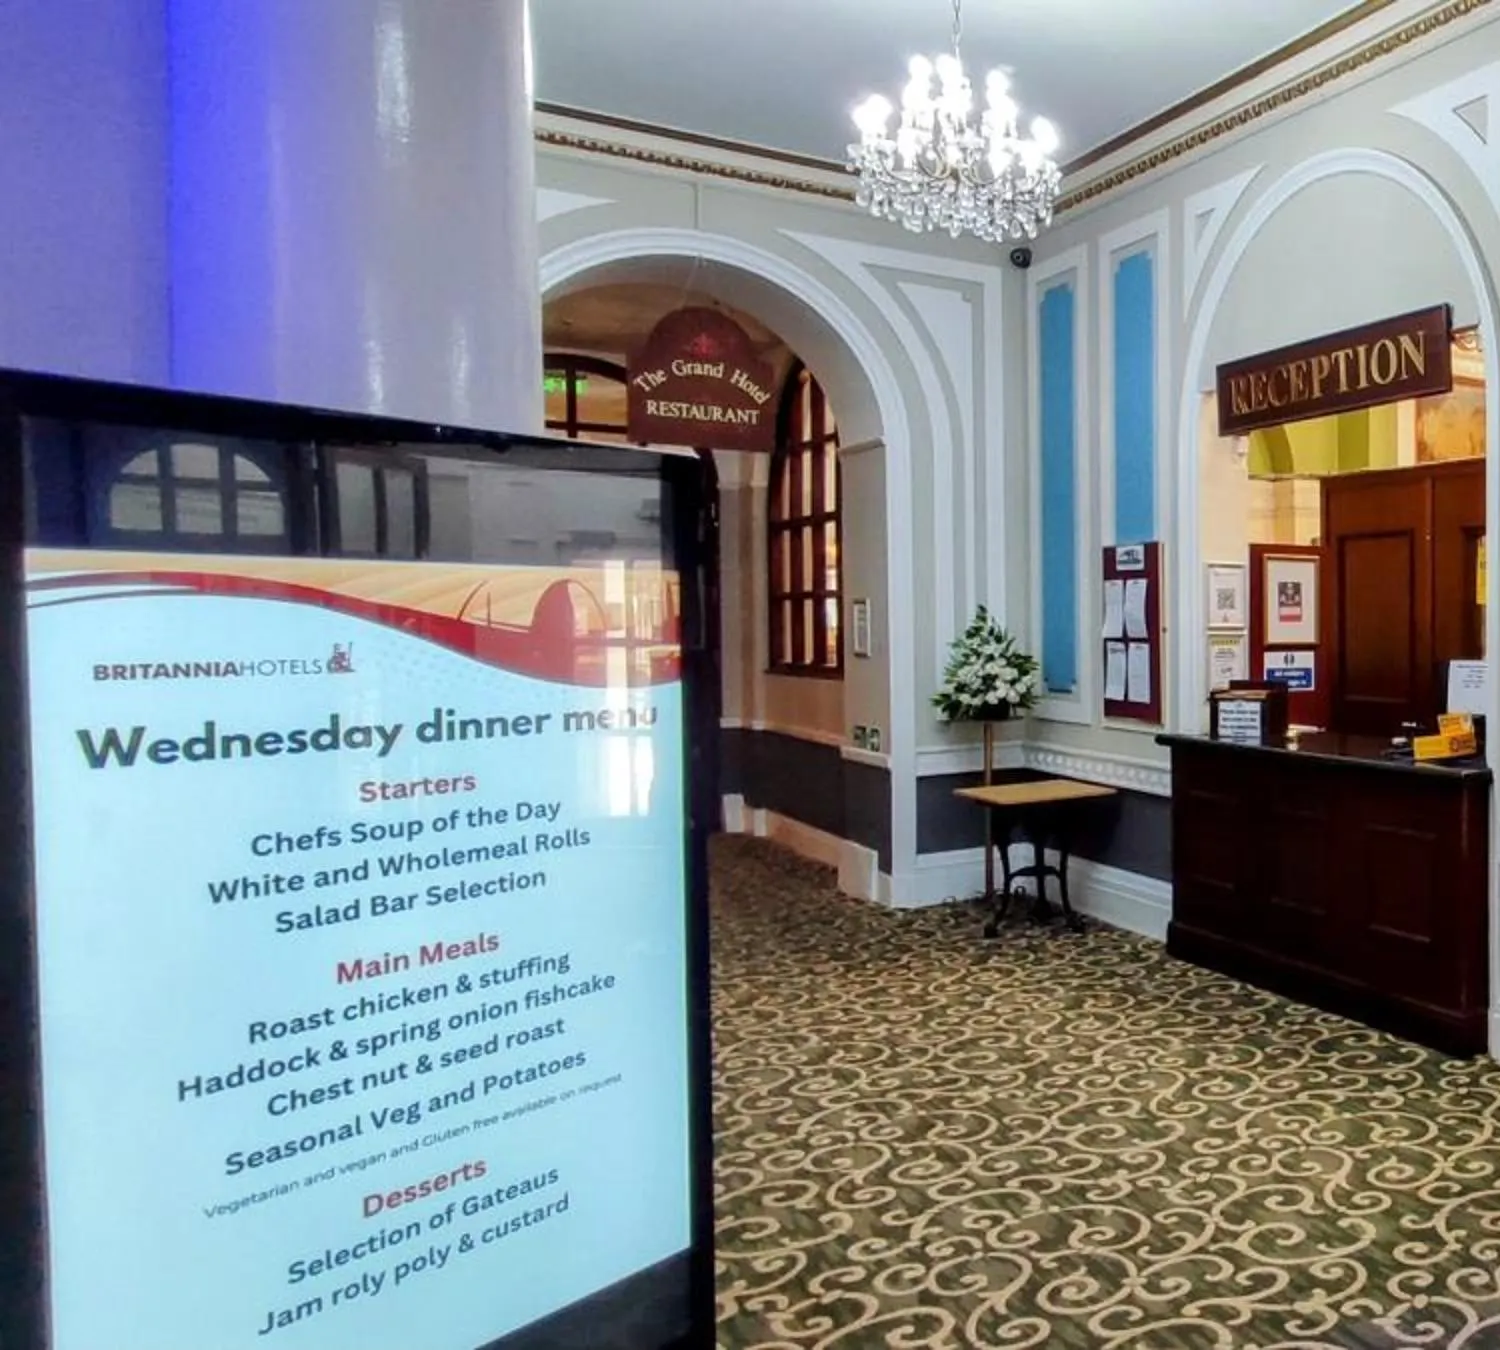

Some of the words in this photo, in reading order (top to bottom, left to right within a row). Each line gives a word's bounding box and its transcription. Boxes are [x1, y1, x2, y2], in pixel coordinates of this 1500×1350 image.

[633, 369, 667, 392] The
[672, 360, 724, 379] Grand
[730, 368, 771, 404] Hotel
[1230, 330, 1427, 416] RECEPTION
[646, 400, 760, 425] RESTAURANT
[75, 713, 404, 769] Wednesday
[416, 707, 552, 744] dinner
[563, 706, 657, 732] menu
[360, 776, 476, 803] Starters
[208, 873, 305, 904] White
[313, 859, 369, 888] and
[377, 835, 528, 877] Wholemeal
[535, 828, 590, 852] Rolls
[251, 826, 342, 857] Chefs
[350, 820, 424, 844] Soup
[432, 809, 460, 832] of
[466, 806, 508, 828] the
[516, 802, 561, 822] Day
[276, 898, 360, 933] Salad
[370, 894, 419, 917] Bar
[426, 872, 546, 906] Selection
[337, 952, 410, 985] Main
[420, 932, 499, 966] Meals
[249, 1008, 336, 1045] Roast
[342, 984, 448, 1021] chicken
[455, 973, 473, 994] &
[479, 953, 570, 989] stuffing
[178, 1047, 321, 1102] Haddock
[328, 1040, 349, 1061] &
[356, 1018, 441, 1056] spring
[448, 1000, 518, 1030] onion
[524, 975, 615, 1010] fishcake
[267, 1078, 354, 1116] Chest
[362, 1062, 408, 1091] nut
[416, 1054, 433, 1075] &
[440, 1033, 498, 1068] seed
[506, 1019, 565, 1049] roast
[226, 1115, 364, 1176] Seasonal
[370, 1101, 421, 1129] Veg
[428, 1081, 475, 1113] and
[483, 1052, 586, 1096] Potatoes
[203, 1180, 300, 1219] Vegetarian
[303, 1166, 336, 1187] and
[338, 1152, 387, 1175] vegan
[390, 1138, 419, 1158] and
[421, 1124, 470, 1147] Gluten
[472, 1115, 499, 1131] free
[501, 1096, 557, 1121] available
[560, 1089, 576, 1101] on
[364, 1161, 486, 1218] Desserts
[258, 1297, 322, 1336] Jam
[332, 1271, 386, 1305] roly
[395, 1245, 451, 1286] poly
[458, 1233, 474, 1253] &
[481, 1192, 568, 1243] custard
[288, 1222, 420, 1284] Selection
[429, 1202, 456, 1229] of
[462, 1169, 559, 1216] Gateaus
